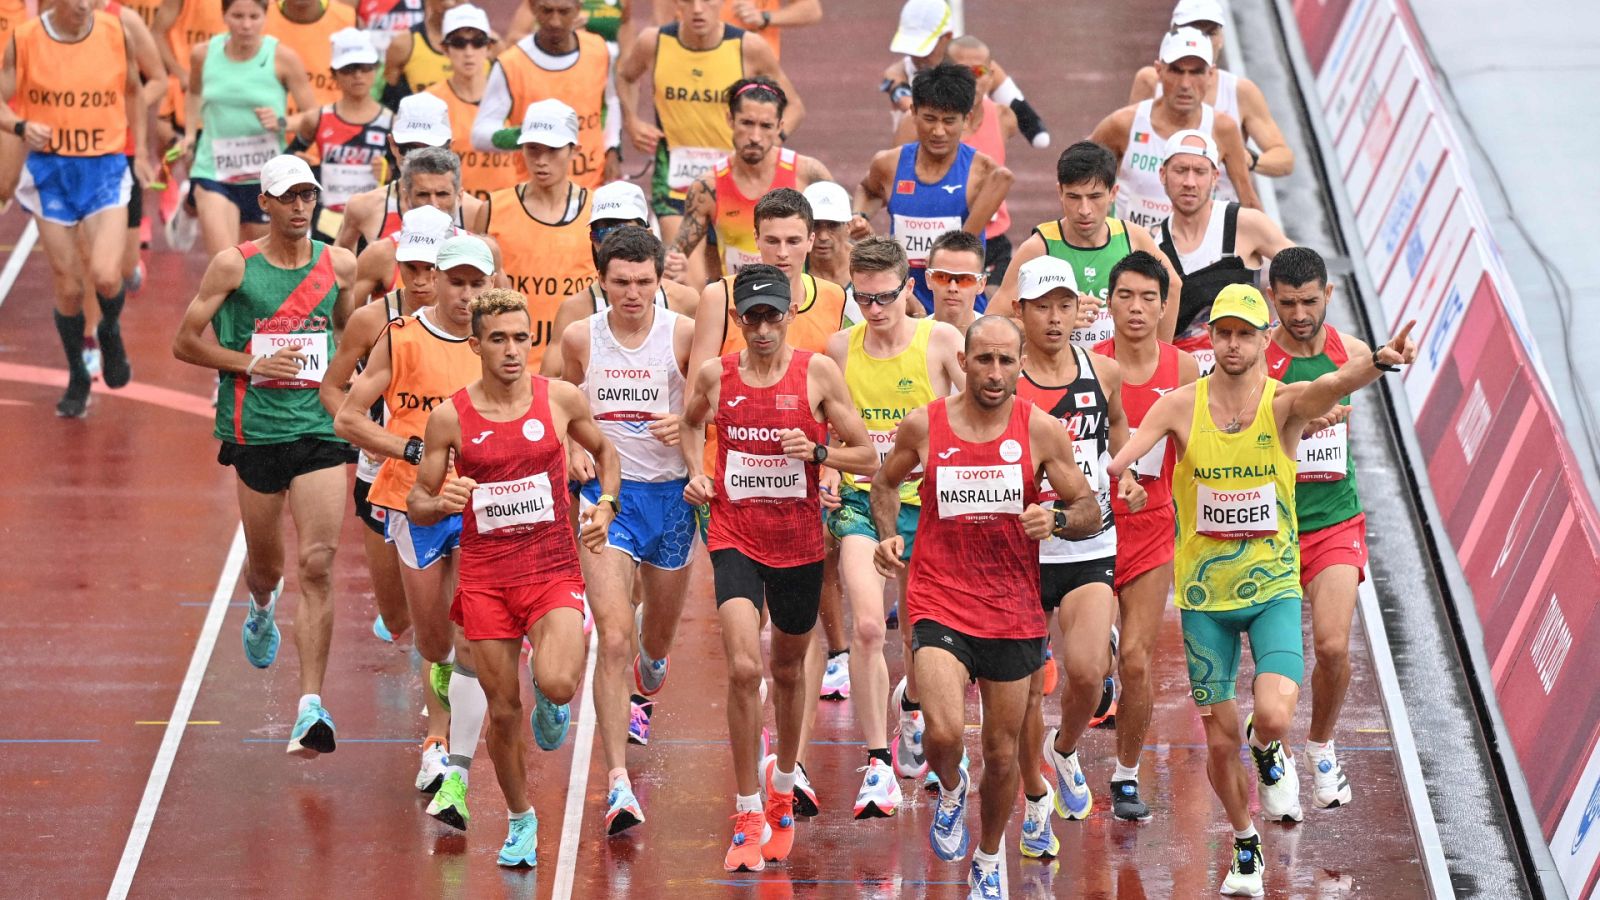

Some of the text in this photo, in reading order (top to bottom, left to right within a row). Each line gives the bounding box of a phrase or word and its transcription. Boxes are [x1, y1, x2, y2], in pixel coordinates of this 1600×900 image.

[80, 90, 117, 108] 2020
[406, 120, 434, 131] JAPAN
[529, 120, 554, 131] JAPAN
[215, 148, 278, 169] PAUTOVA
[905, 219, 945, 230] TOYOTA
[408, 234, 437, 245] JAPAN
[1038, 274, 1067, 285] JAPAN
[1085, 330, 1097, 341] da
[1099, 330, 1115, 341] SIL
[270, 337, 314, 347] TOYOTA
[604, 369, 651, 379] TOYOTA
[597, 388, 660, 402] GAVRILOV
[1306, 446, 1342, 462] HARTI
[740, 456, 789, 468] TOYOTA
[954, 469, 1005, 480] TOYOTA
[1194, 463, 1277, 480] AUSTRALIA
[730, 473, 800, 489] CHENTOUF
[488, 480, 536, 496] TOYOTA
[940, 488, 1021, 504] NASRALLAH
[1211, 491, 1262, 502] TOYOTA
[485, 497, 545, 518] BOUKHILI
[1203, 504, 1271, 525] ROEGER
